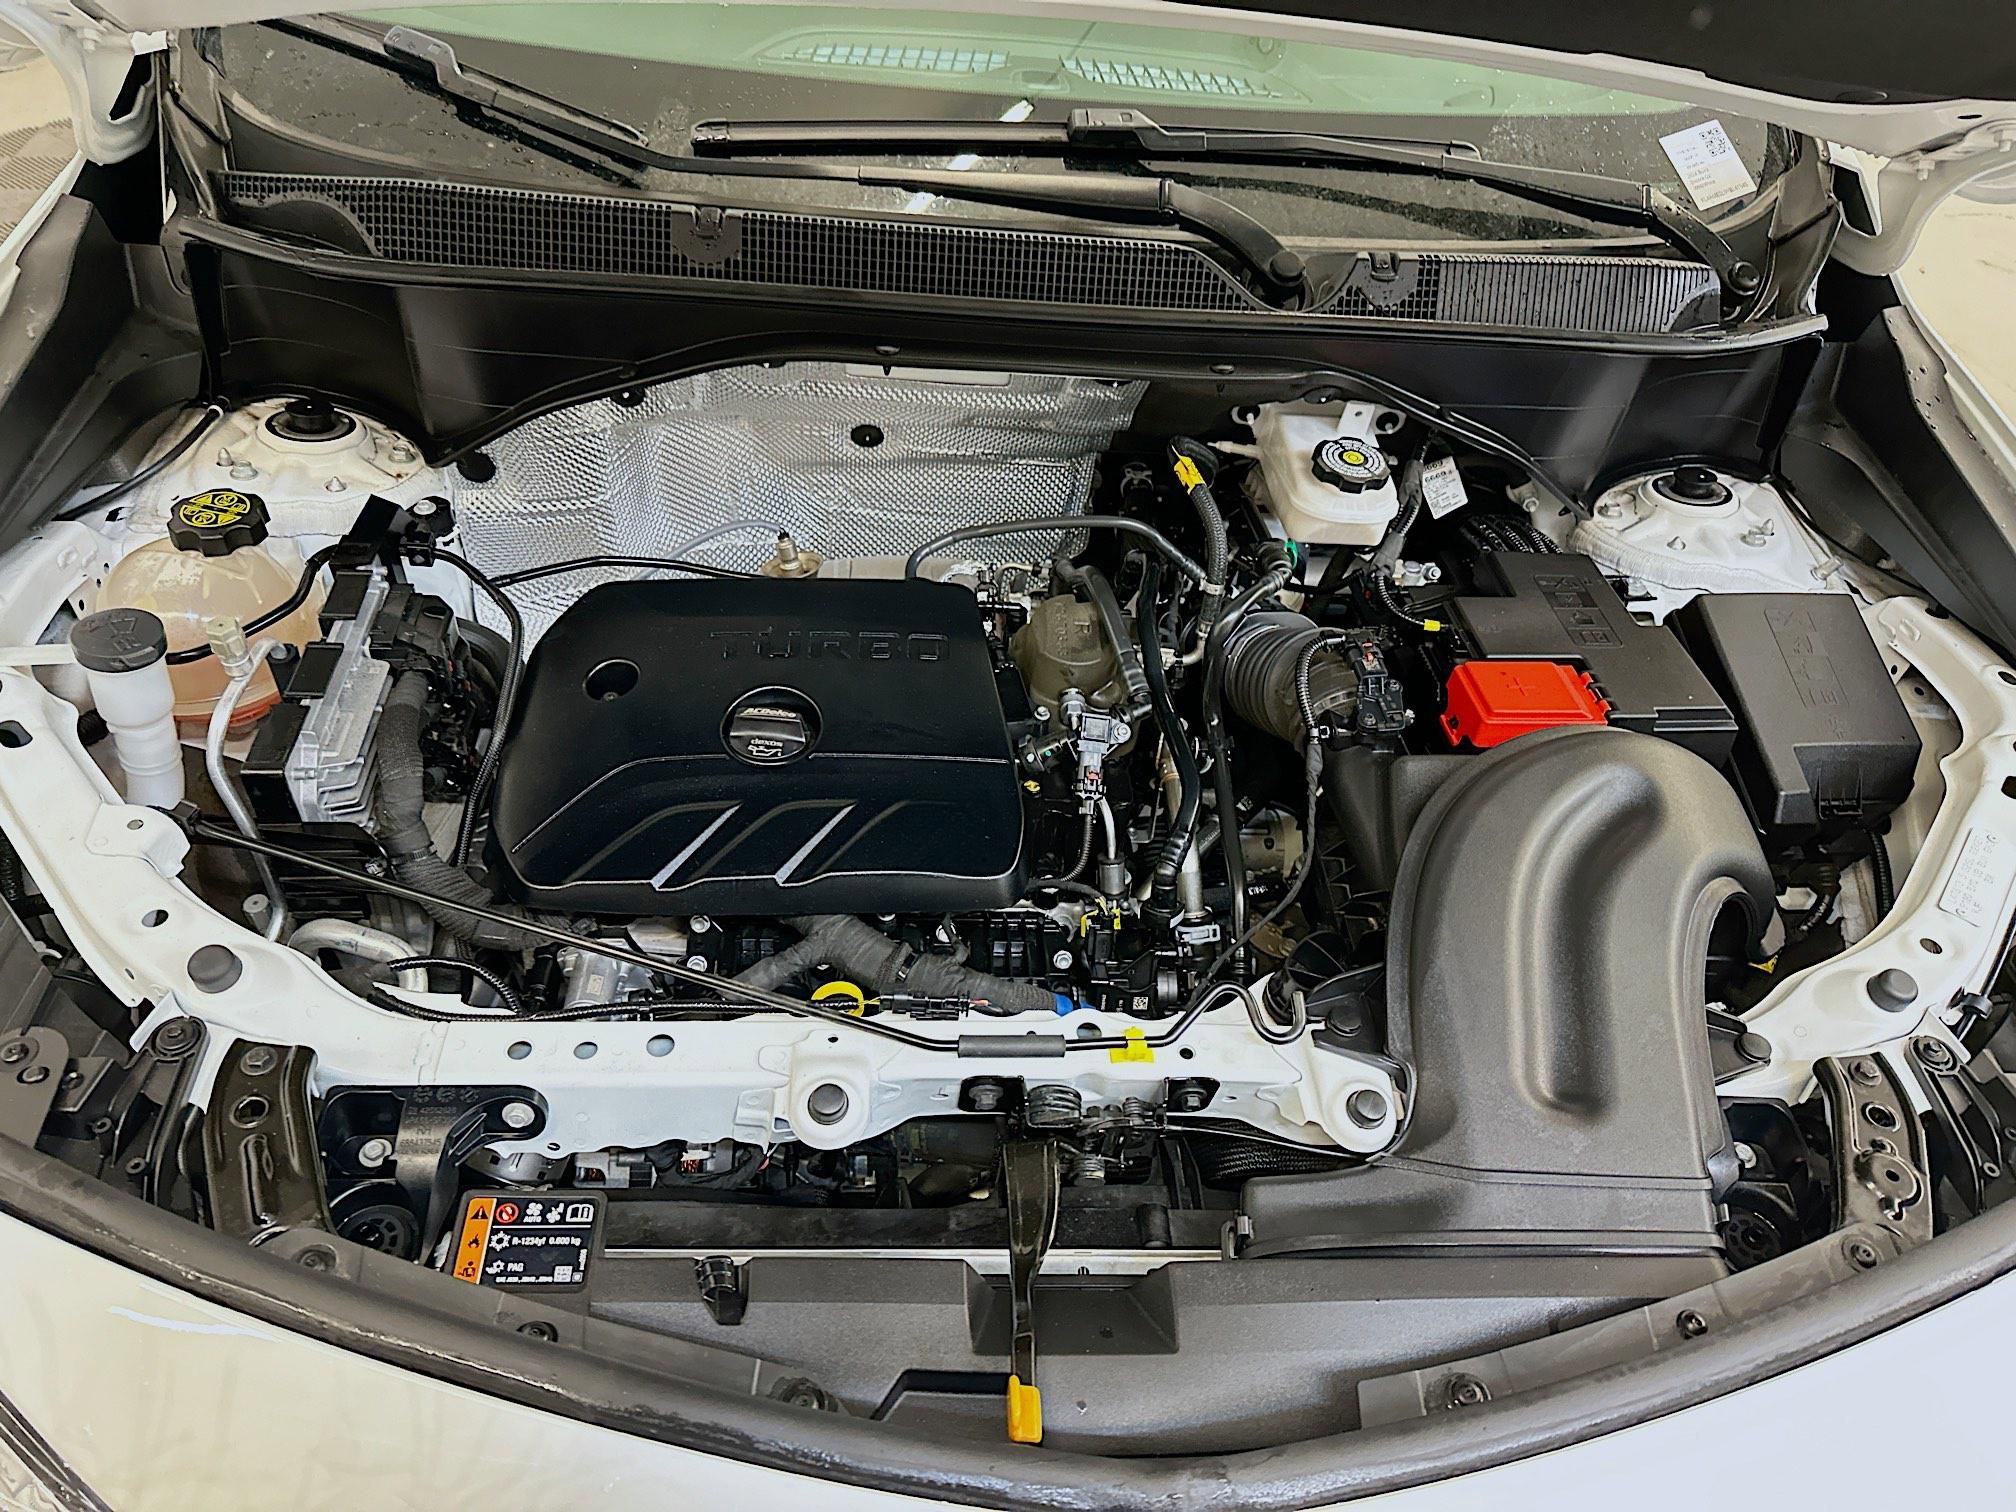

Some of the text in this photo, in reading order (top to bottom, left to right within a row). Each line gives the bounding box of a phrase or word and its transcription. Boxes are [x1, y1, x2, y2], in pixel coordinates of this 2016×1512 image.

[710, 630, 949, 661] TURBO
[740, 707, 797, 718] ACDelco
[750, 737, 784, 747] dexos
[523, 1215, 542, 1223] AUTO
[511, 1236, 547, 1247] R-1234yf
[570, 1236, 582, 1247] kg
[507, 1262, 524, 1272] PAG
